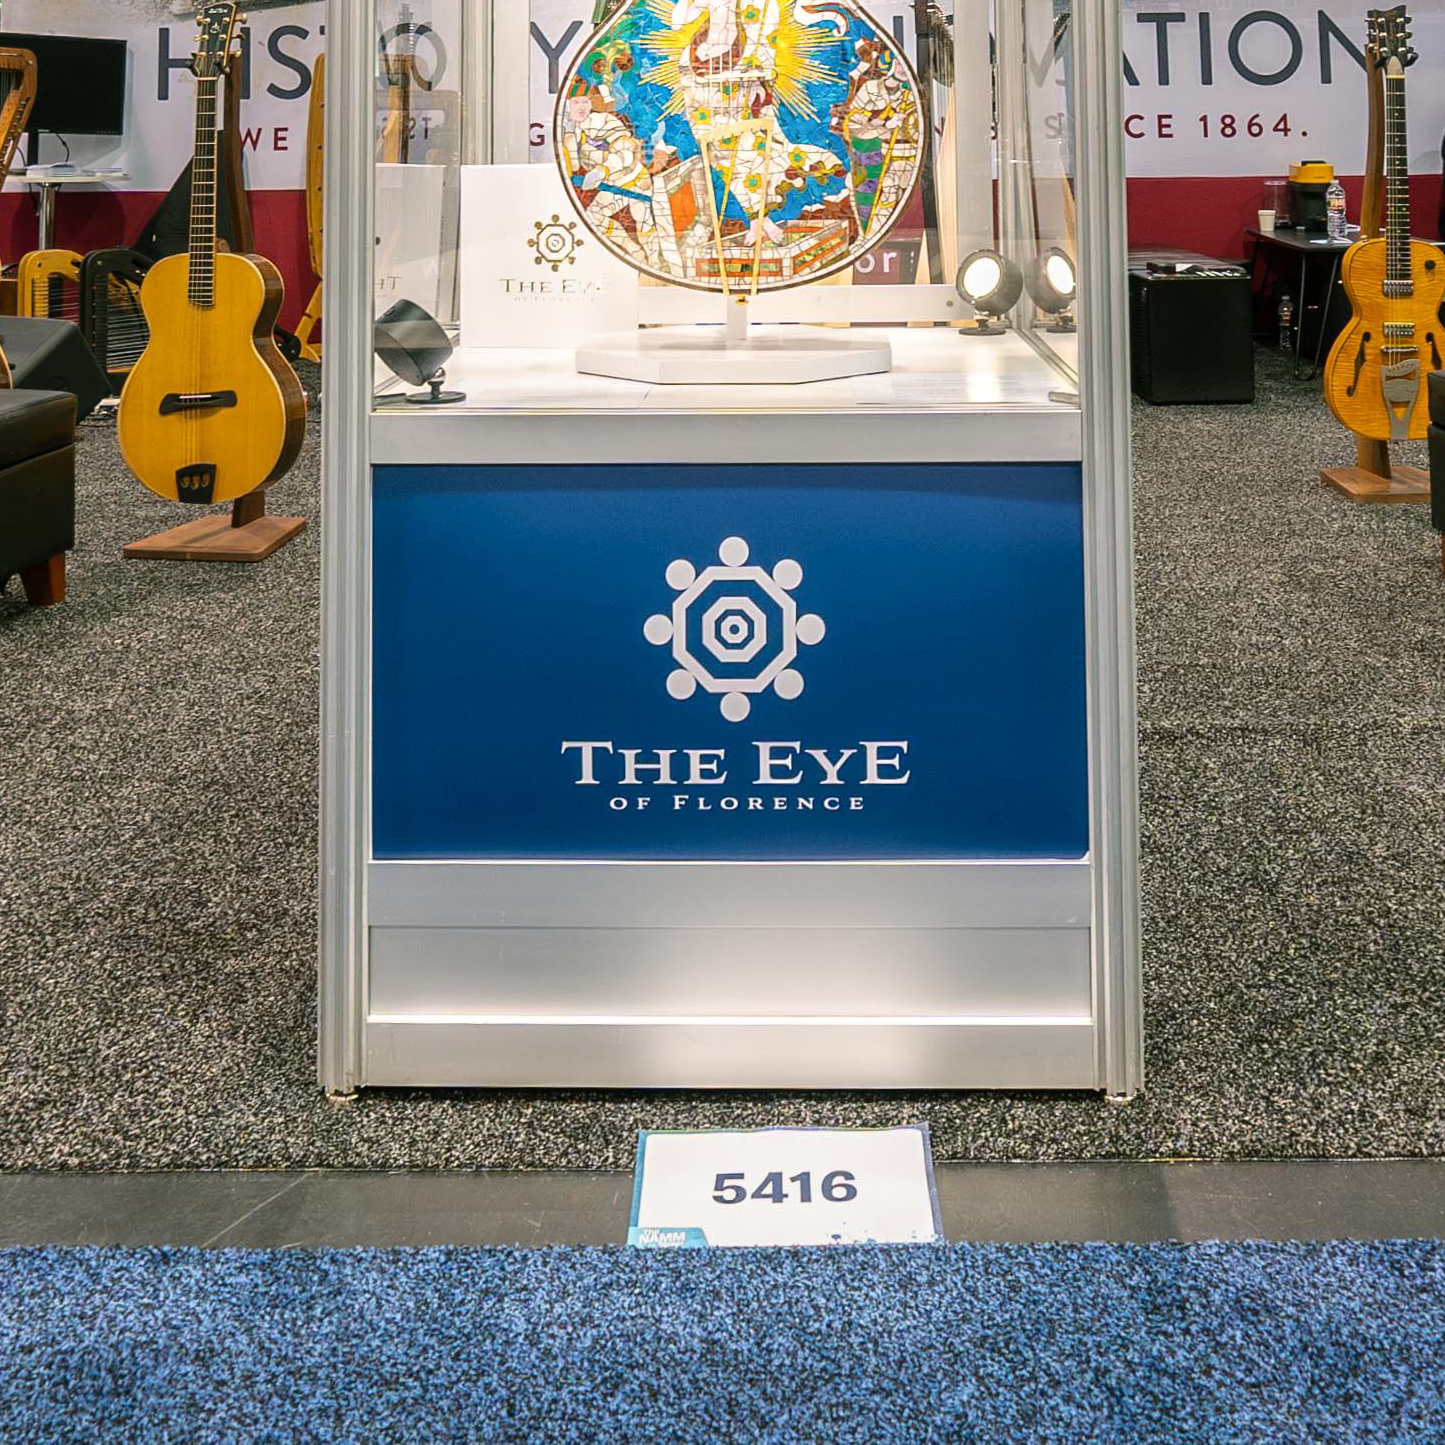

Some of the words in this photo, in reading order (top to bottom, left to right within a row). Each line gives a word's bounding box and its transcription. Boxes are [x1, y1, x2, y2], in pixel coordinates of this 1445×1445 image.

[1199, 112, 1308, 139] 1864.
[609, 796, 651, 810] OF
[673, 794, 864, 811] FLORENCE
[712, 1170, 858, 1205] 5416
